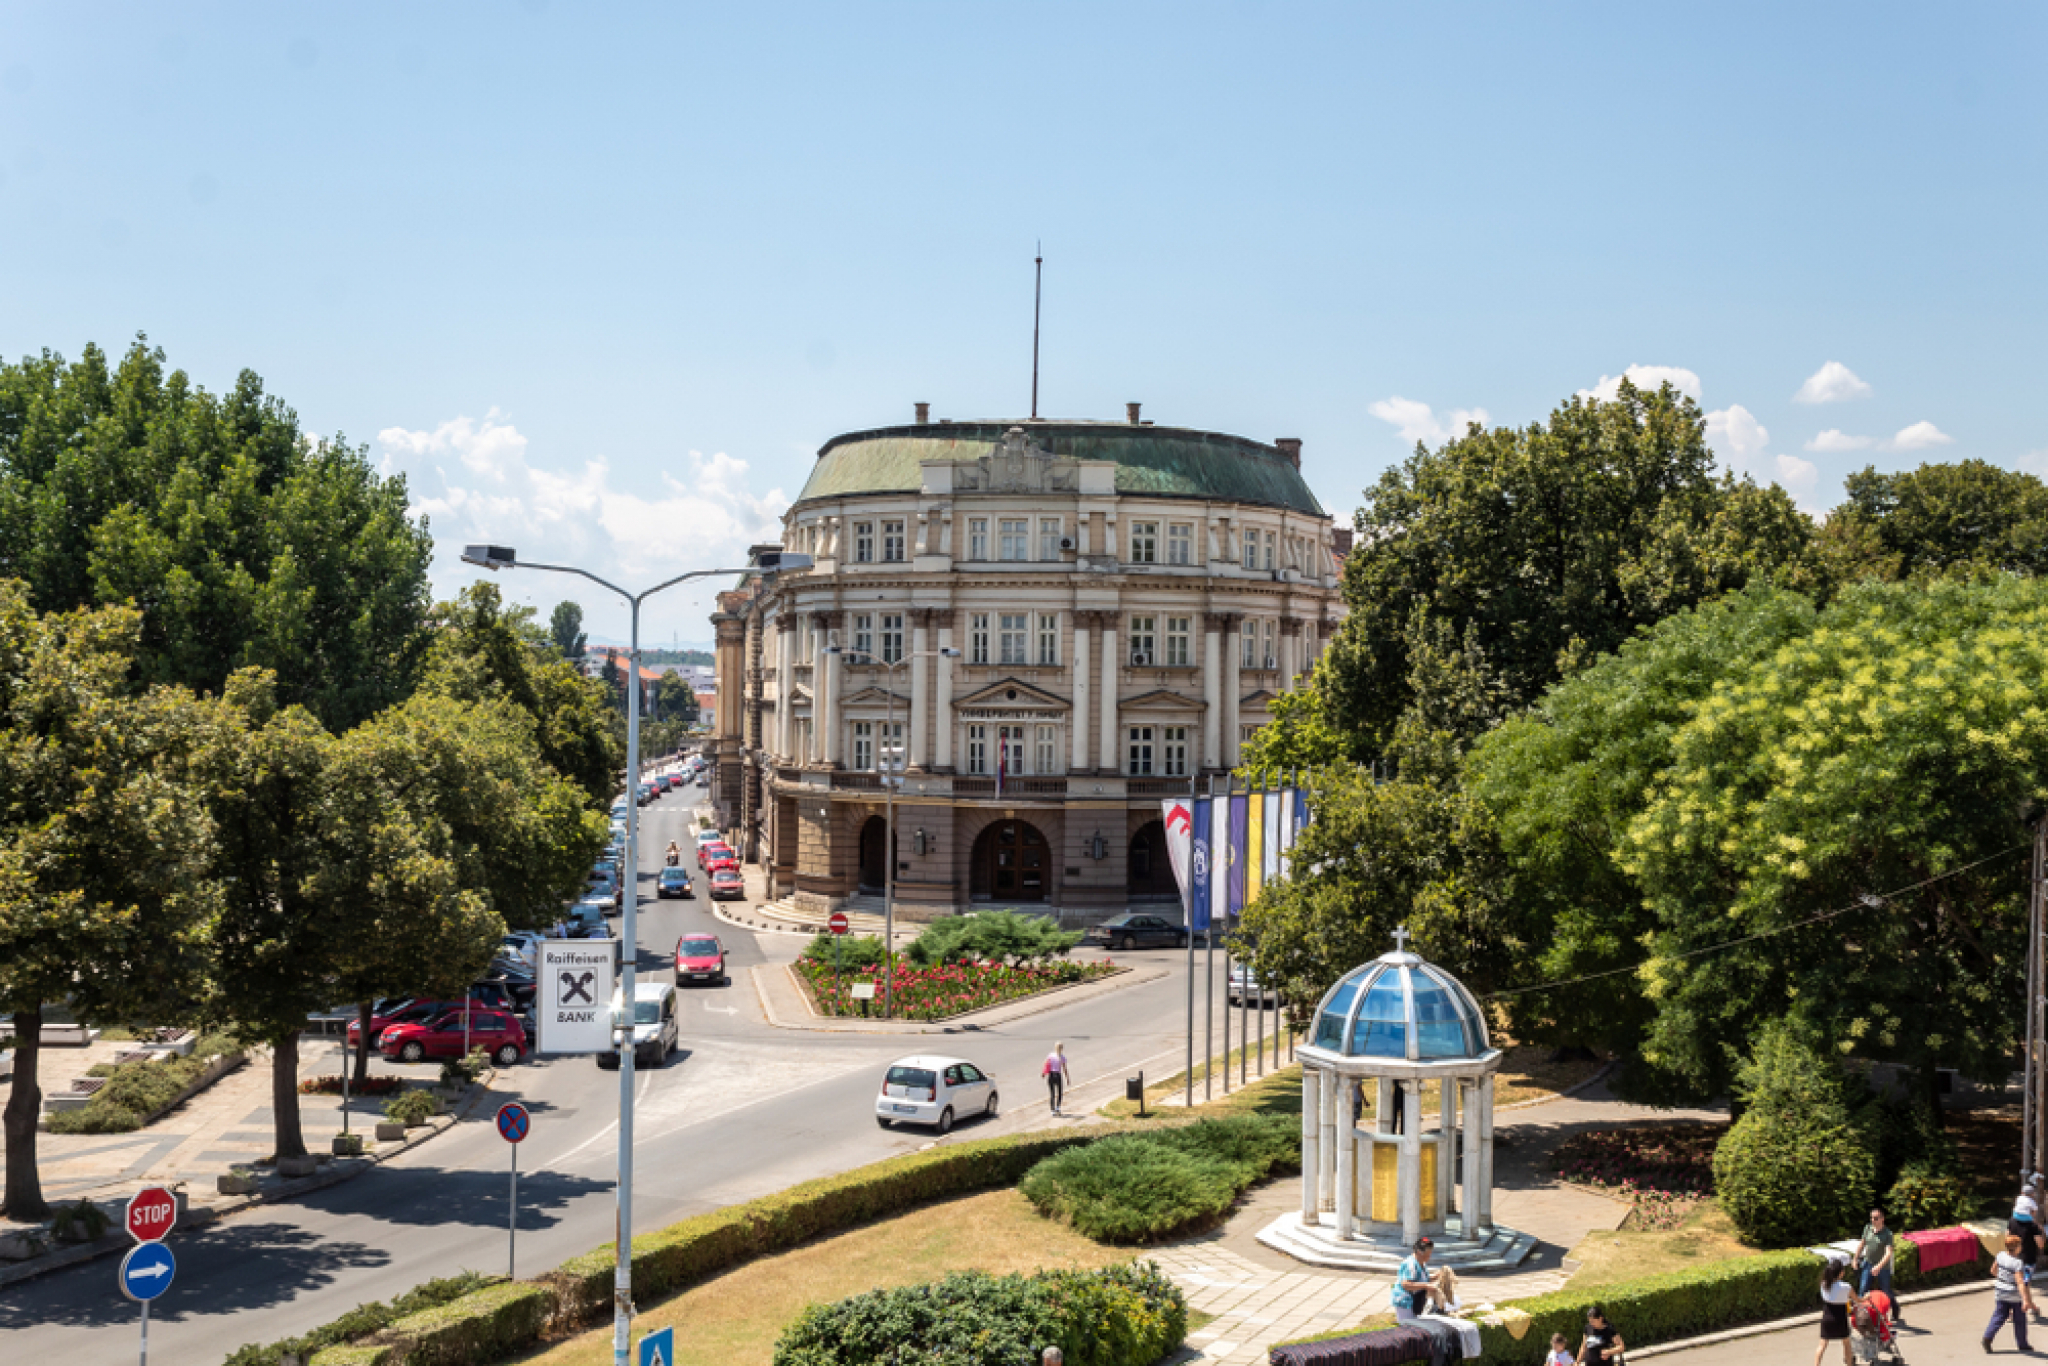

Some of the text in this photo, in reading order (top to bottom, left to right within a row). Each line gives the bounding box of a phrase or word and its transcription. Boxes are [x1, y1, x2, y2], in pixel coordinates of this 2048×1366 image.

[546, 951, 609, 965] Raiffeisen
[556, 1011, 596, 1023] BANK
[132, 1203, 171, 1226] STOP
